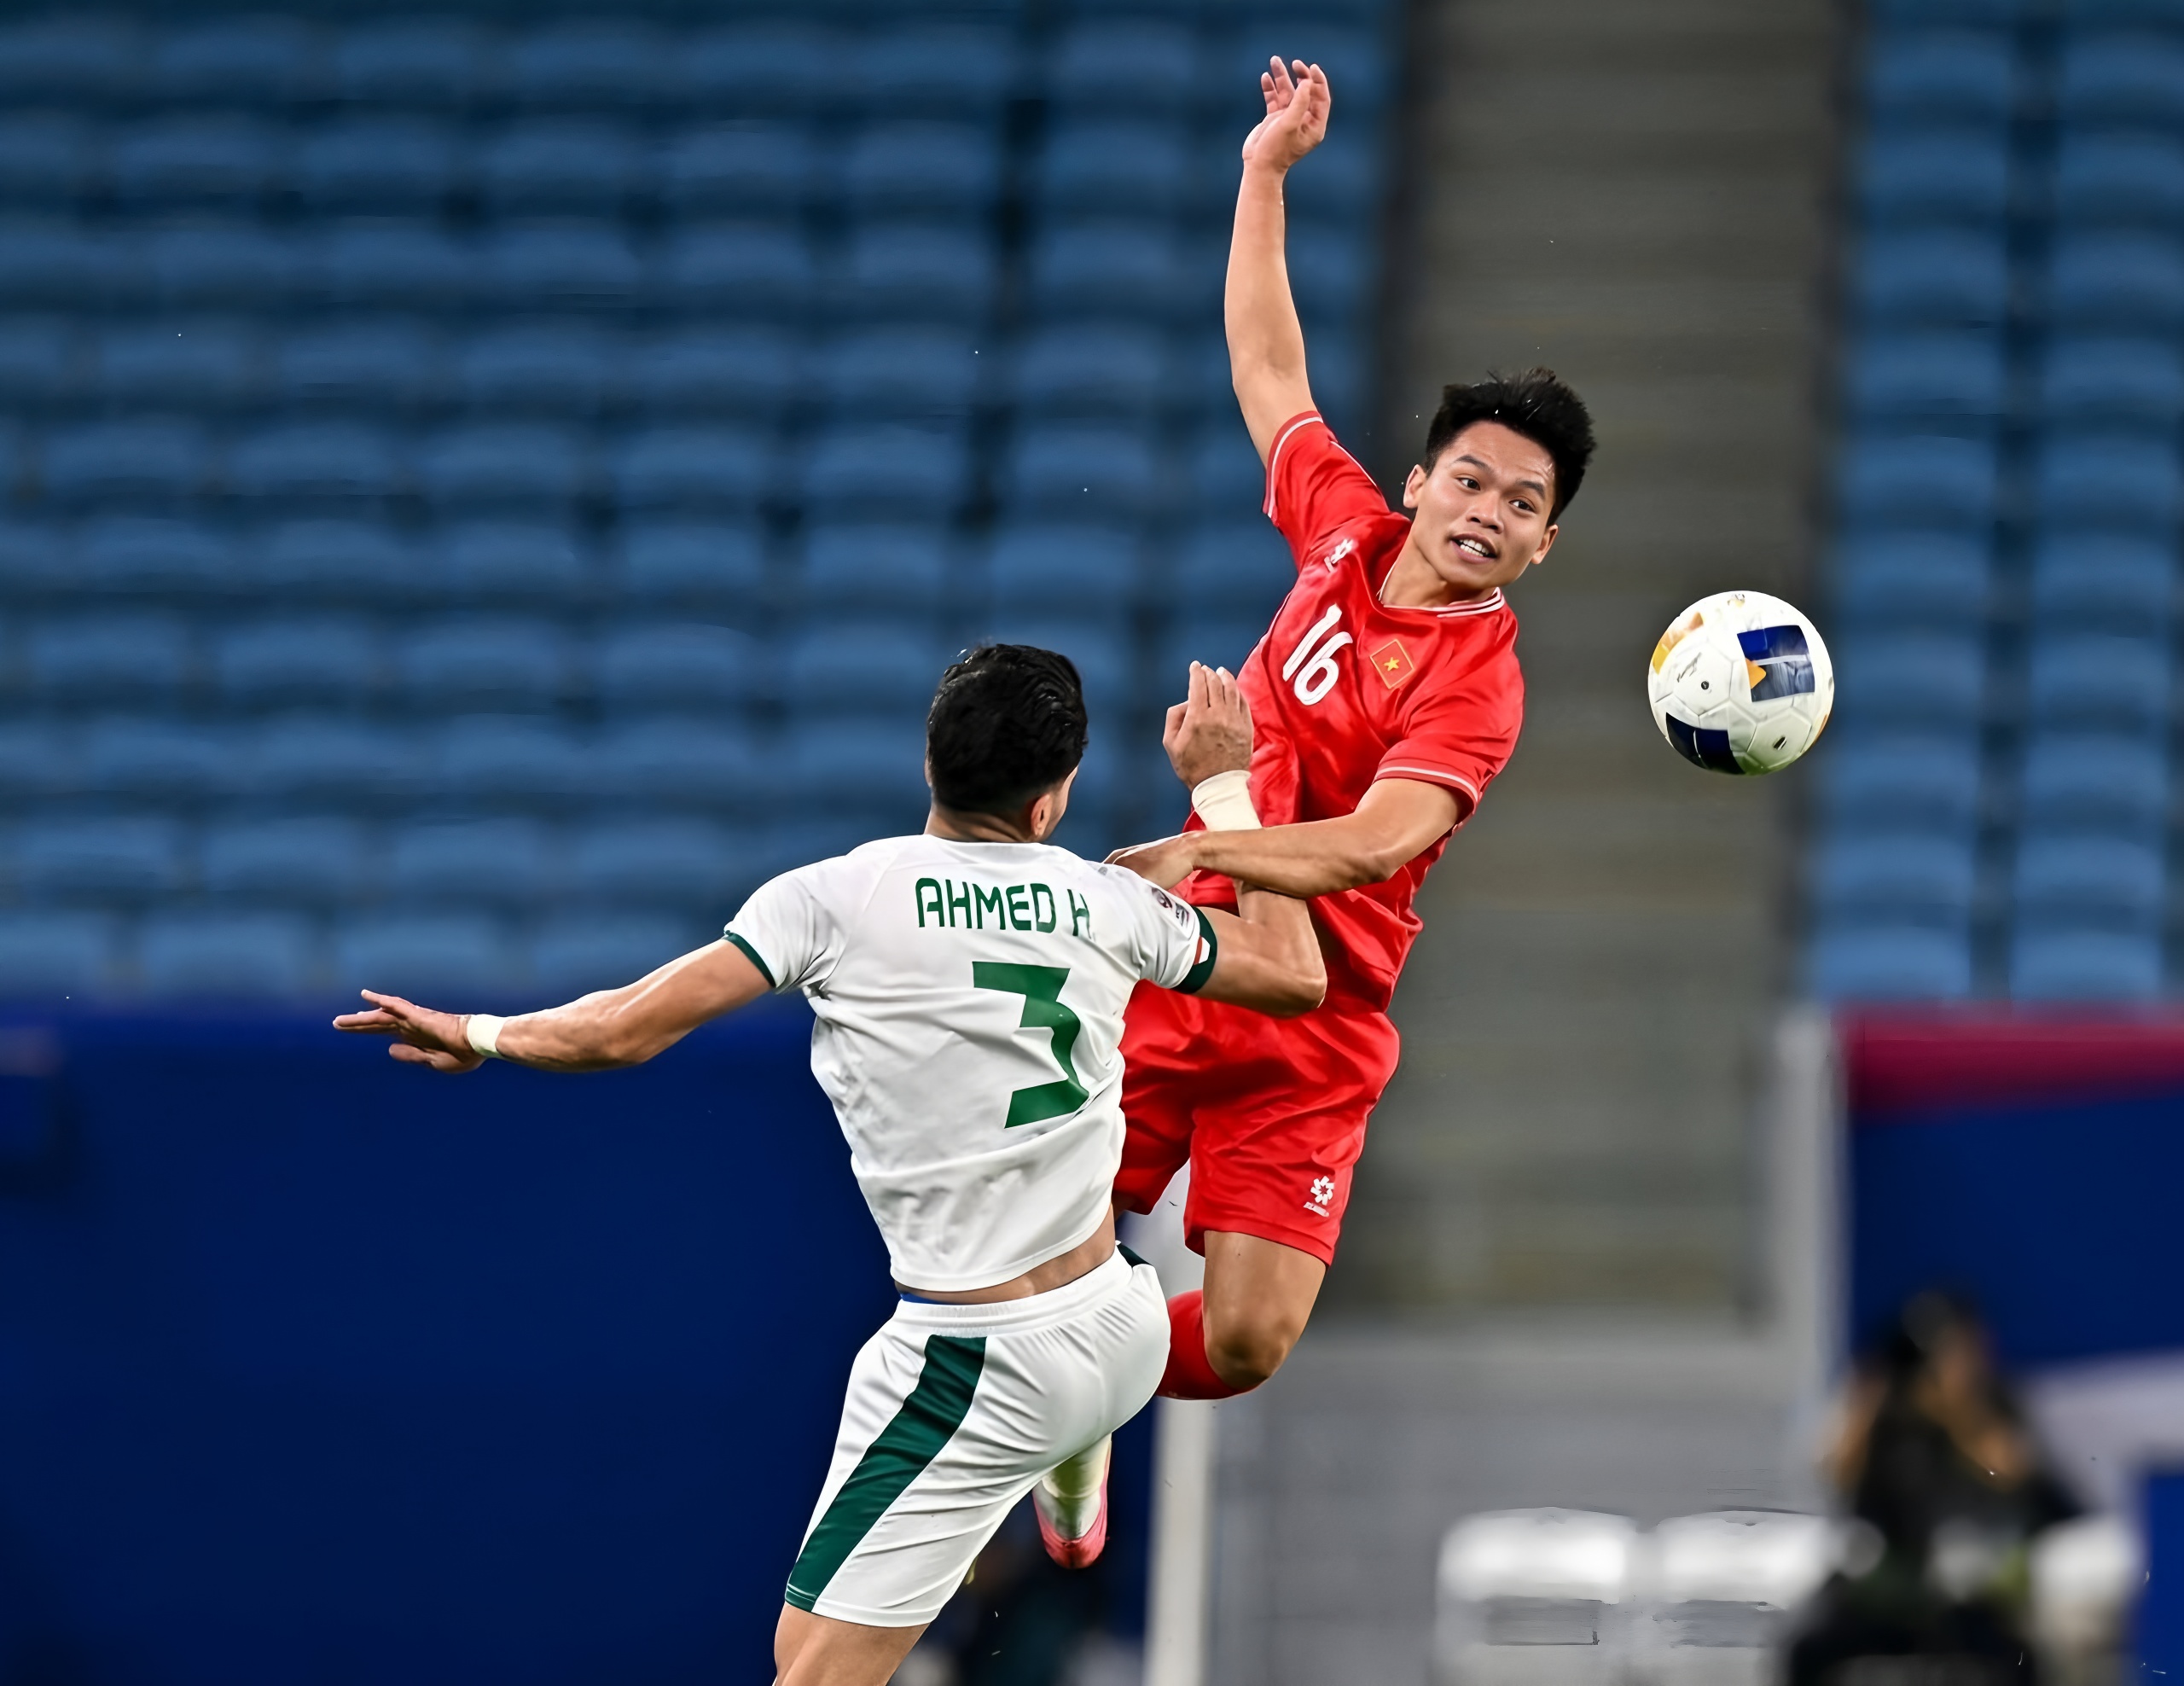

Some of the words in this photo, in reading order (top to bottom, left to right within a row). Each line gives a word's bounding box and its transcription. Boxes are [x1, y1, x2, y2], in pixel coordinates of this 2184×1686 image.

[1282, 602, 1353, 706] 16
[915, 877, 1057, 933] AHMED
[972, 961, 1089, 1129] 3
